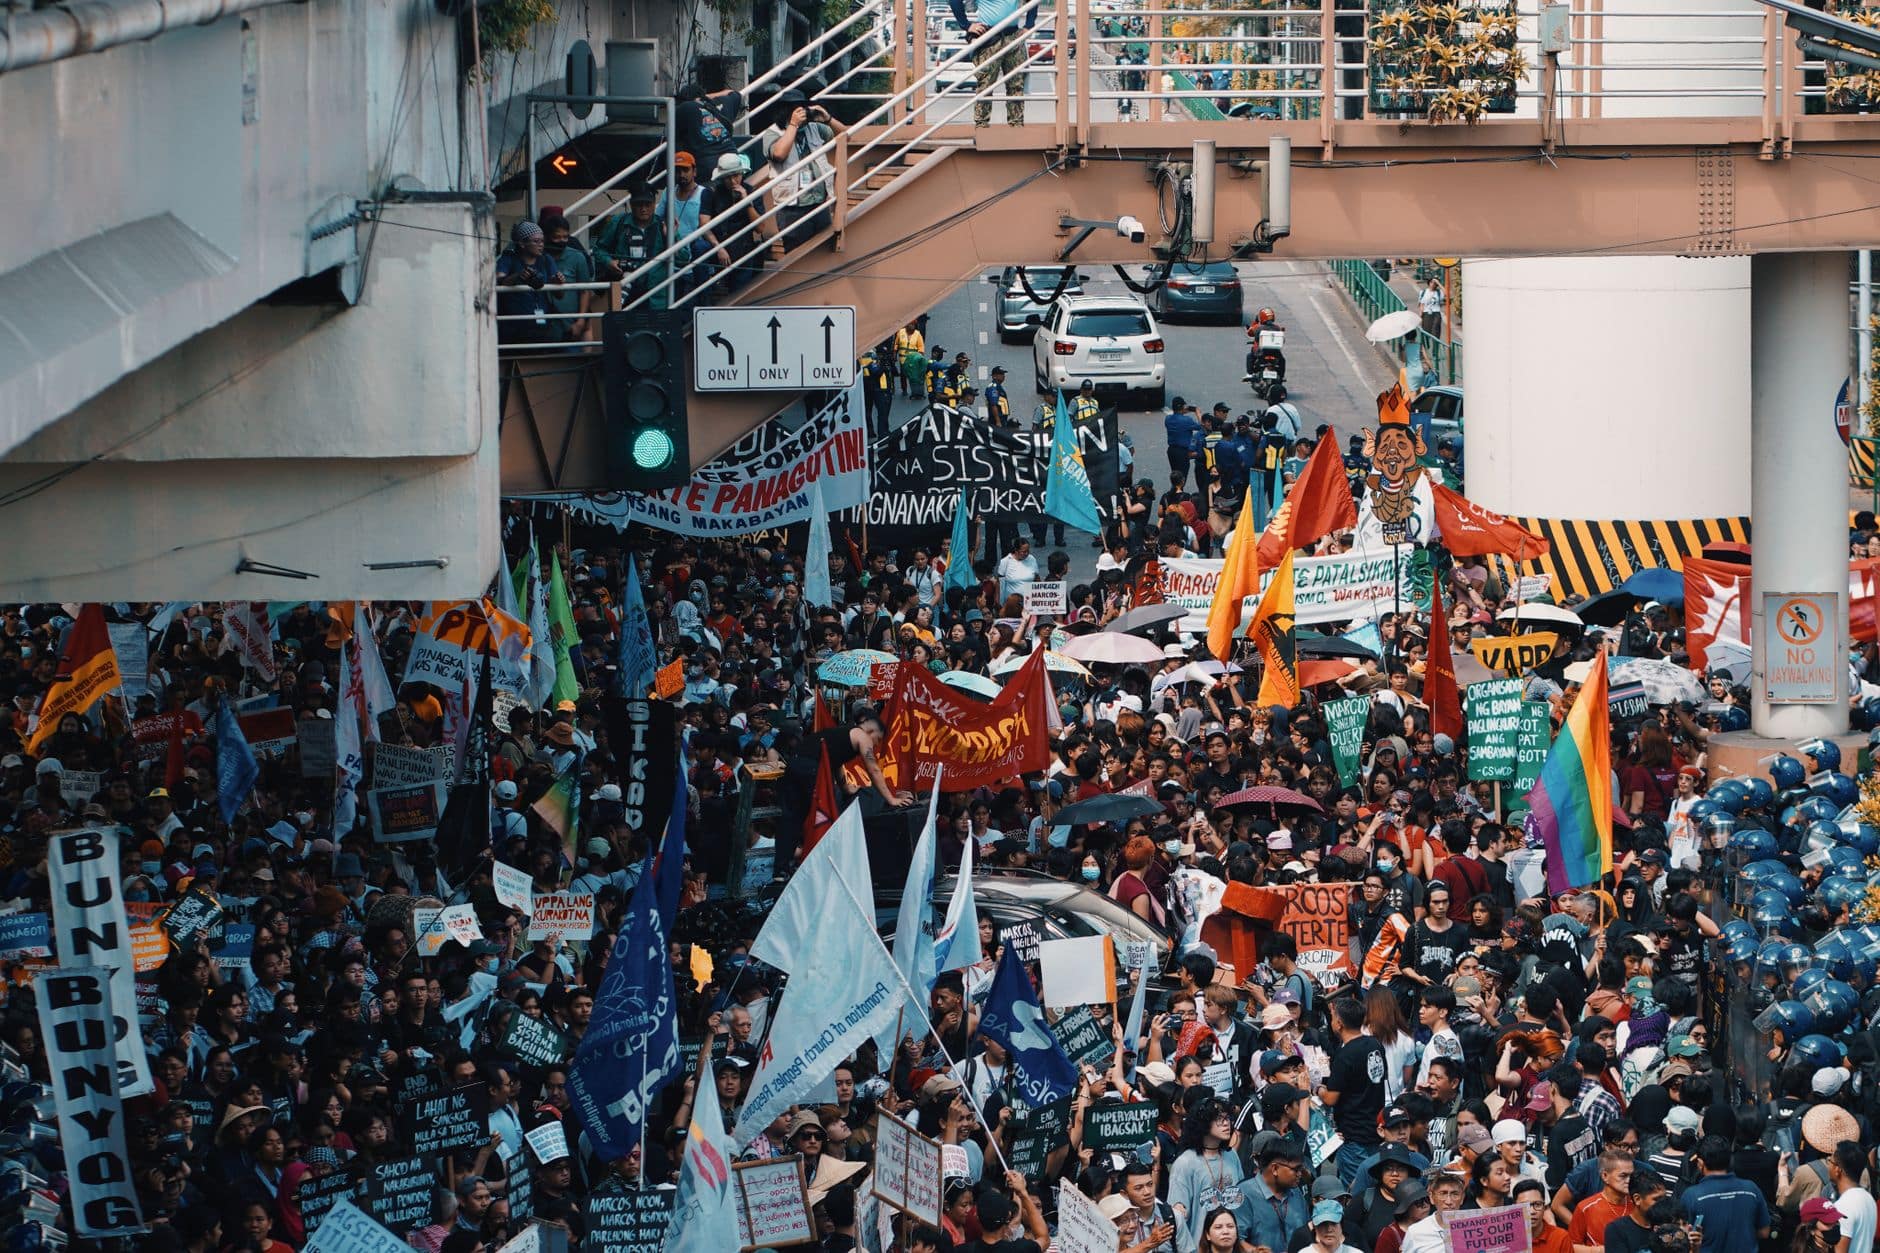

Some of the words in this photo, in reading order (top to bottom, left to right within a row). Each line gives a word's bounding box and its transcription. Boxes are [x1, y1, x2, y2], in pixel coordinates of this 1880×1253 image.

[708, 369, 738, 381] ONLY
[759, 368, 790, 380] ONLY
[813, 366, 843, 379] ONLY
[745, 391, 851, 478] FORGET!
[712, 427, 867, 515] PANAGUTIN!
[895, 458, 924, 476] NA
[932, 444, 1051, 487] SISTEM
[692, 492, 810, 531] MAKABAYAN
[1786, 647, 1816, 665] NO
[1769, 666, 1833, 685] JAYWALKING
[1531, 705, 1544, 718] NG
[1485, 735, 1506, 745] ANG
[567, 895, 593, 908] LANG
[404, 1074, 428, 1090] END
[46, 975, 140, 1231] BUNYOG
[416, 1096, 449, 1121] LAHAT
[452, 1092, 466, 1111] NG
[1040, 1109, 1056, 1123] END
[1091, 1107, 1160, 1124] IMPERYALISMO
[589, 1196, 632, 1214] MARCOS
[600, 1212, 637, 1227] MARCOS
[1450, 1218, 1488, 1230] DEMAND
[1489, 1210, 1521, 1224] BETTER
[1463, 1228, 1484, 1239] IT'S
[1487, 1222, 1514, 1235] OUR
[1465, 1233, 1515, 1250] FUTURE!
